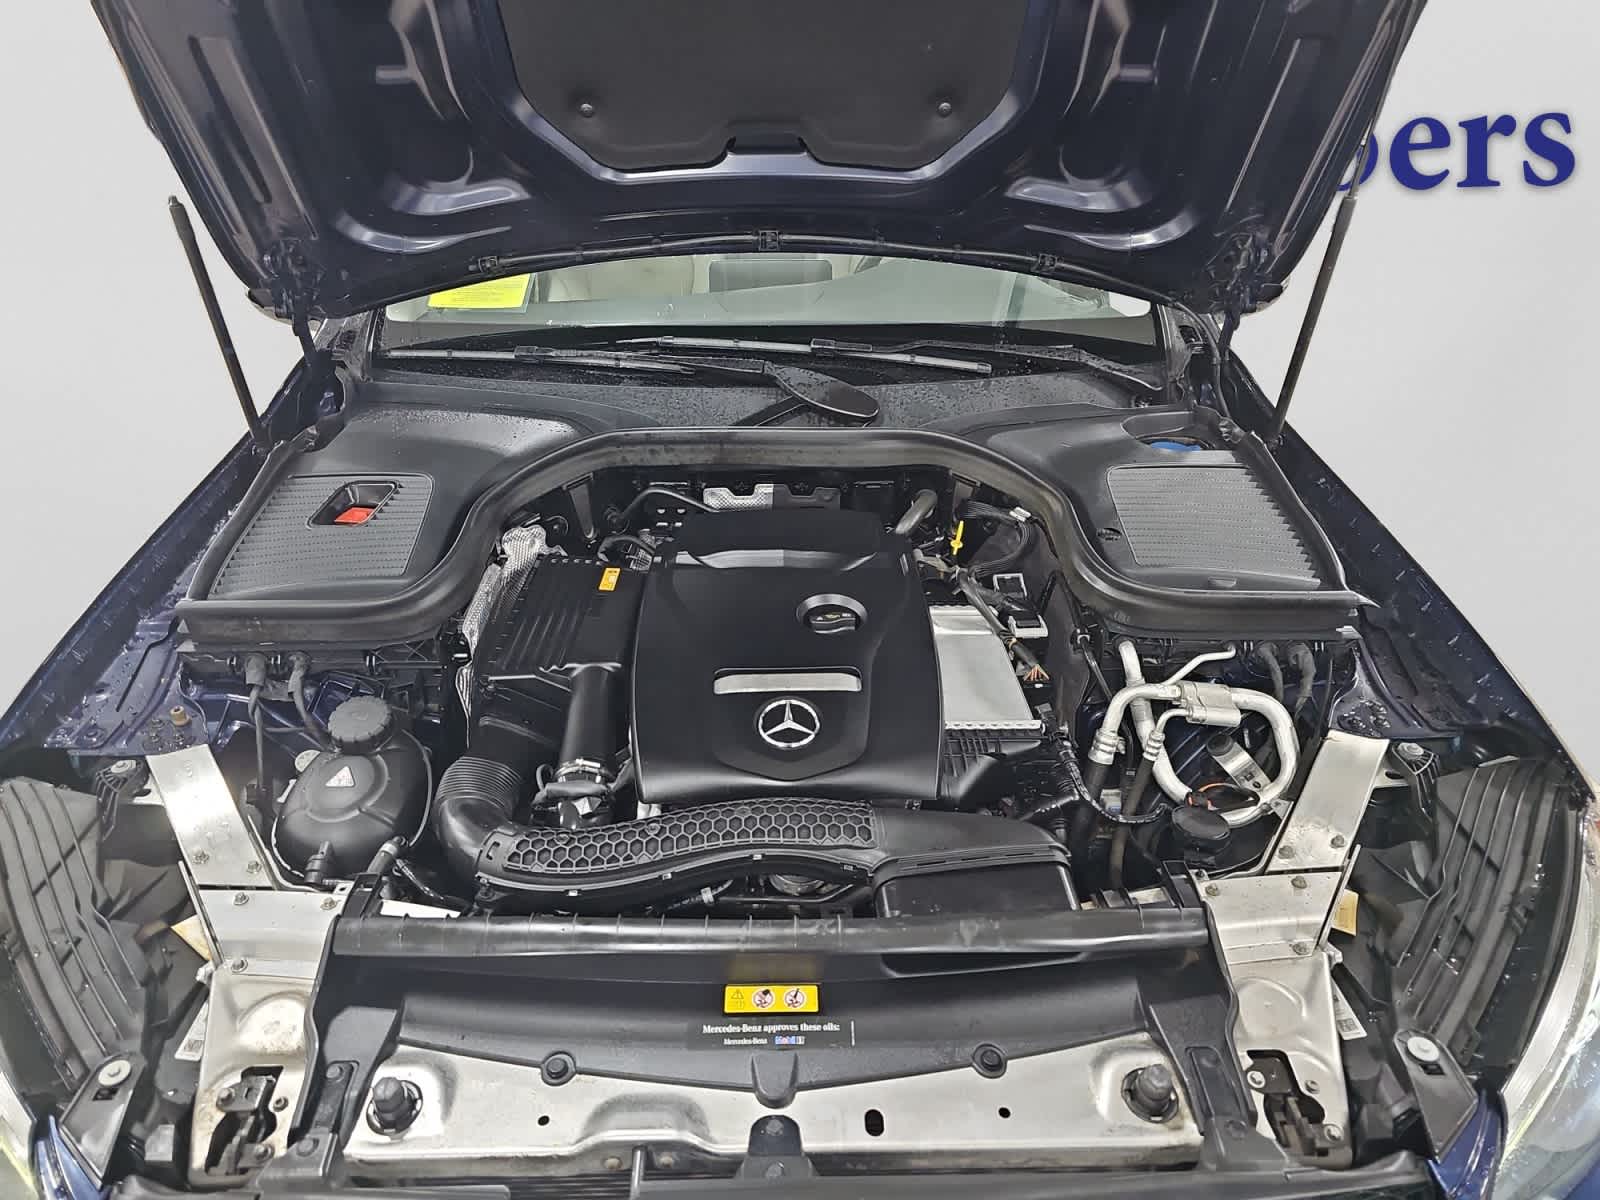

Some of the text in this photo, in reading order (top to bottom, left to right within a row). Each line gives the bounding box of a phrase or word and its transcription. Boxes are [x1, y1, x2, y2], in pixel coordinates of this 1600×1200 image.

[702, 1021, 840, 1034] Mercedes-Benz approves these oils:
